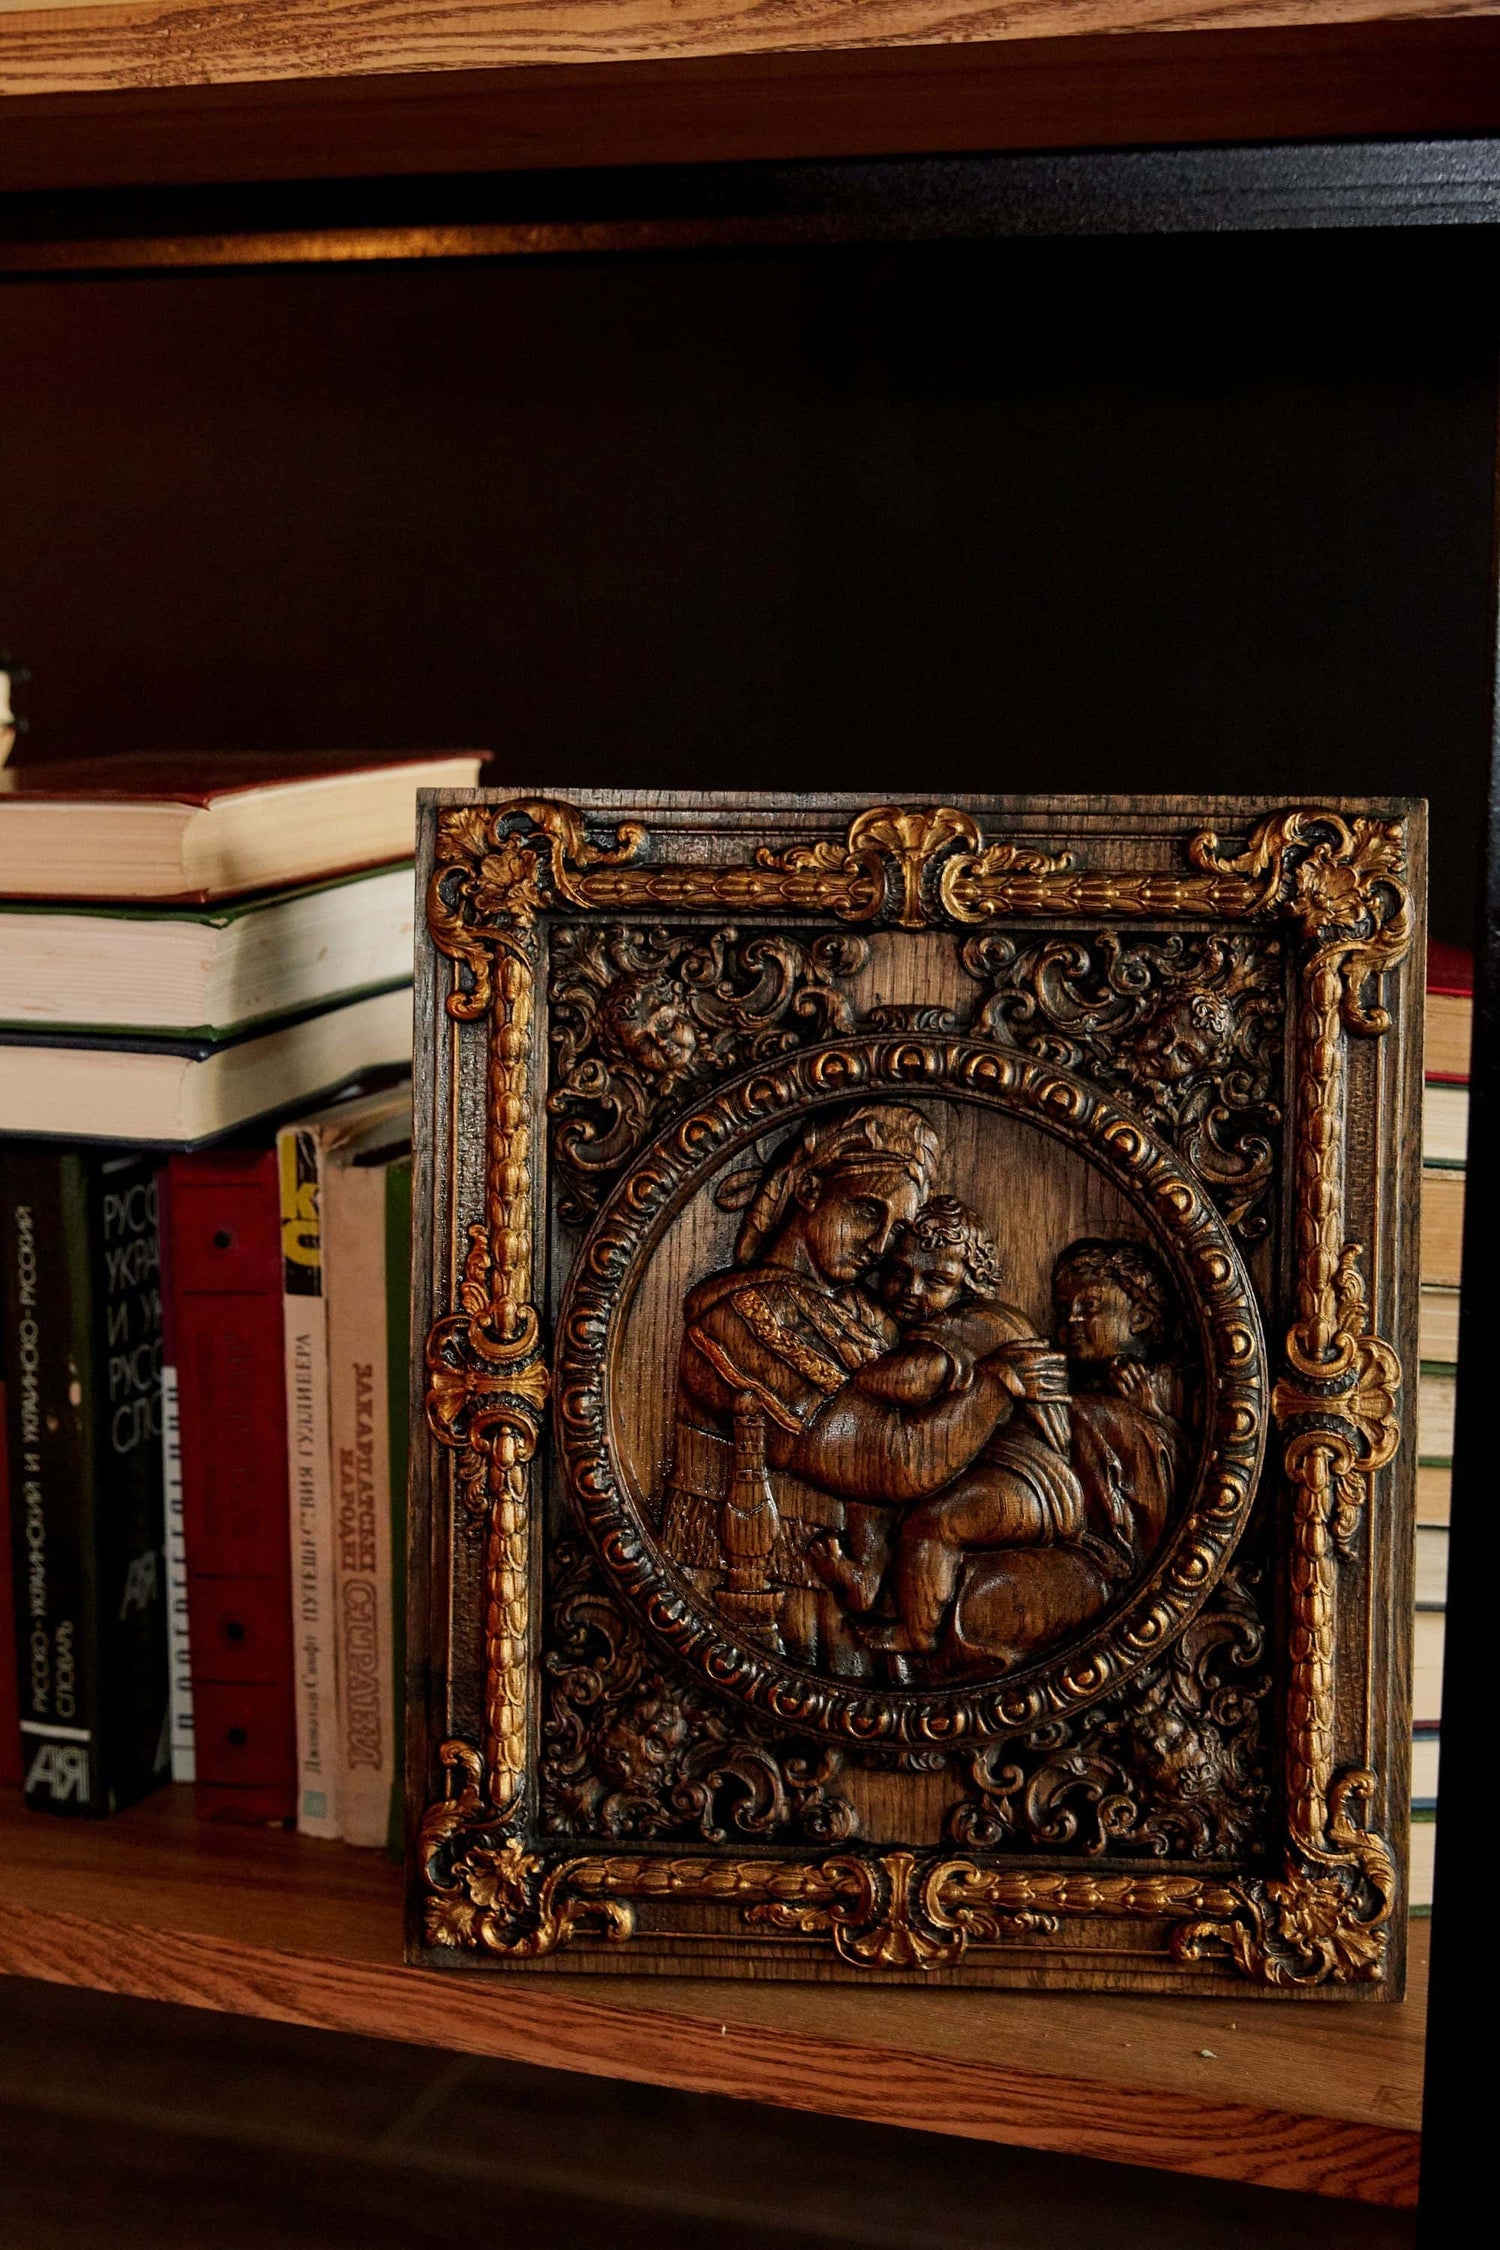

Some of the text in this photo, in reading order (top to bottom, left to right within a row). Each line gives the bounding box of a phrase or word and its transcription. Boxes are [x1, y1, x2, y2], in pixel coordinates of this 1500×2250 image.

[107, 1300, 129, 1349] И
[294, 1333, 314, 1457] ГУЛЛИВЕРА
[22, 1453, 41, 1472] И
[339, 1447, 356, 1573] НАРОДНІ
[353, 1363, 377, 1573] ЗАКАРПАТСЬКІ
[53, 1619, 77, 1718] СЛОВАРЬ
